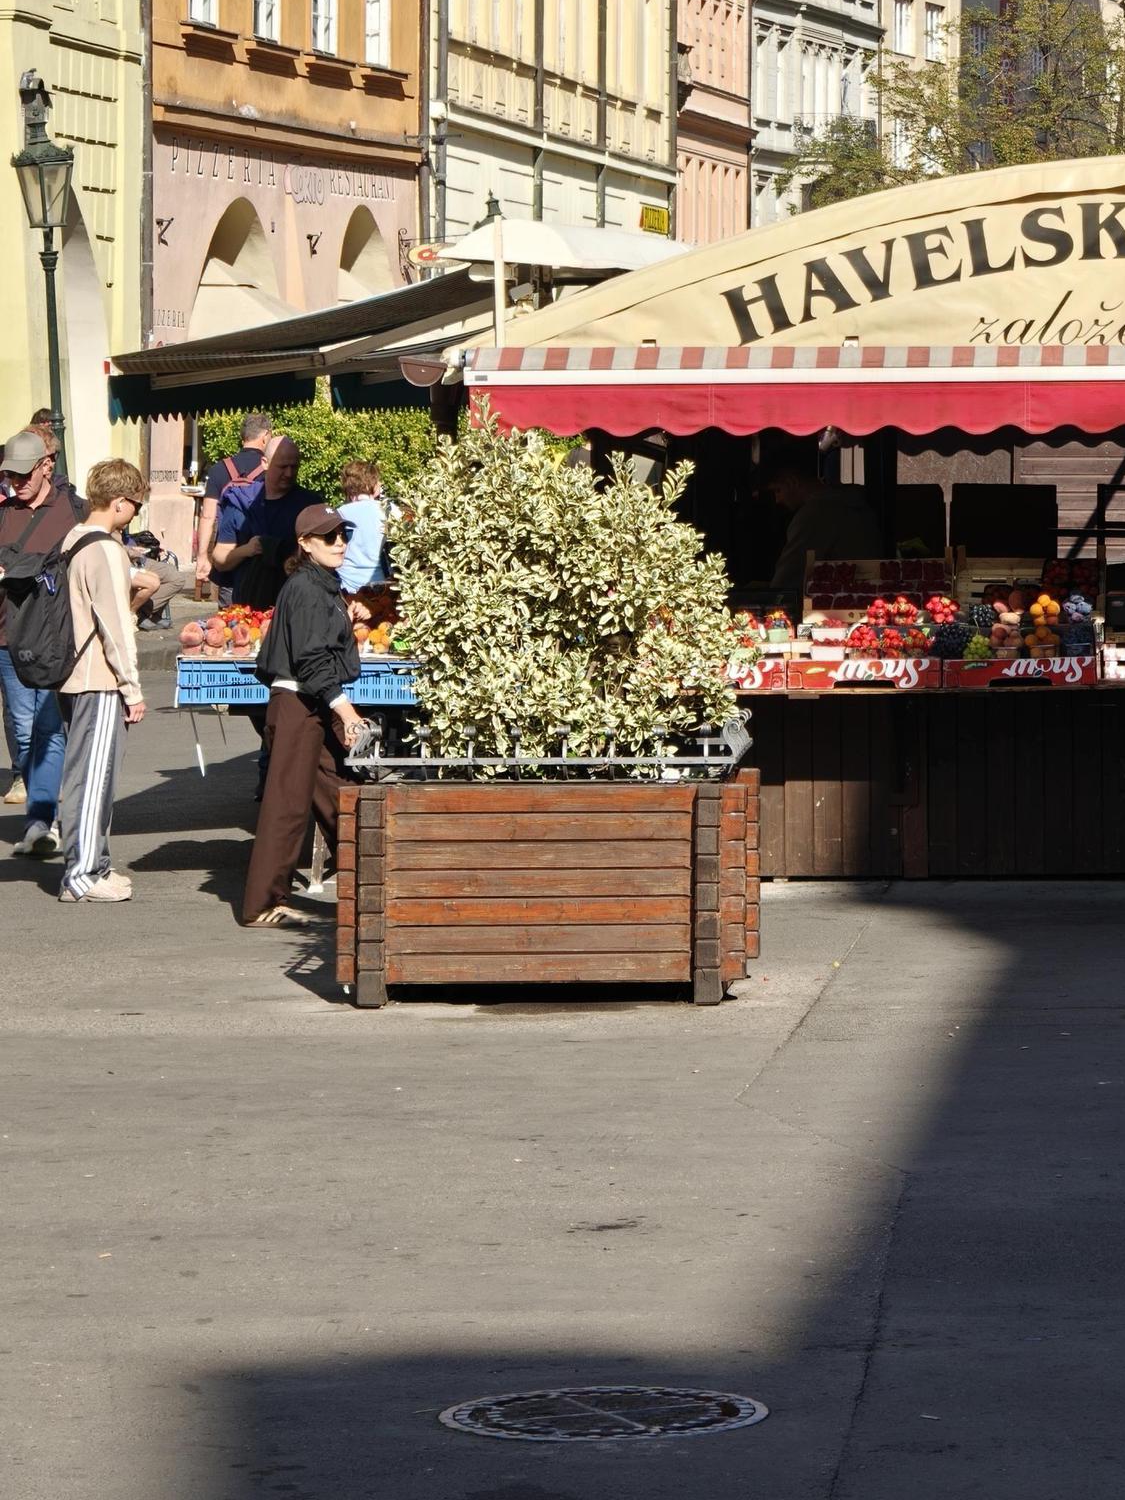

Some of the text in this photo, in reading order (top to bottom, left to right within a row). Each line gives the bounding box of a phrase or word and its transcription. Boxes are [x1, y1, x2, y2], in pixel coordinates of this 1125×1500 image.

[171, 137, 276, 186] PIZZERIA
[328, 162, 396, 201] RESTAURANT
[1002, 657, 1092, 682] Snow
